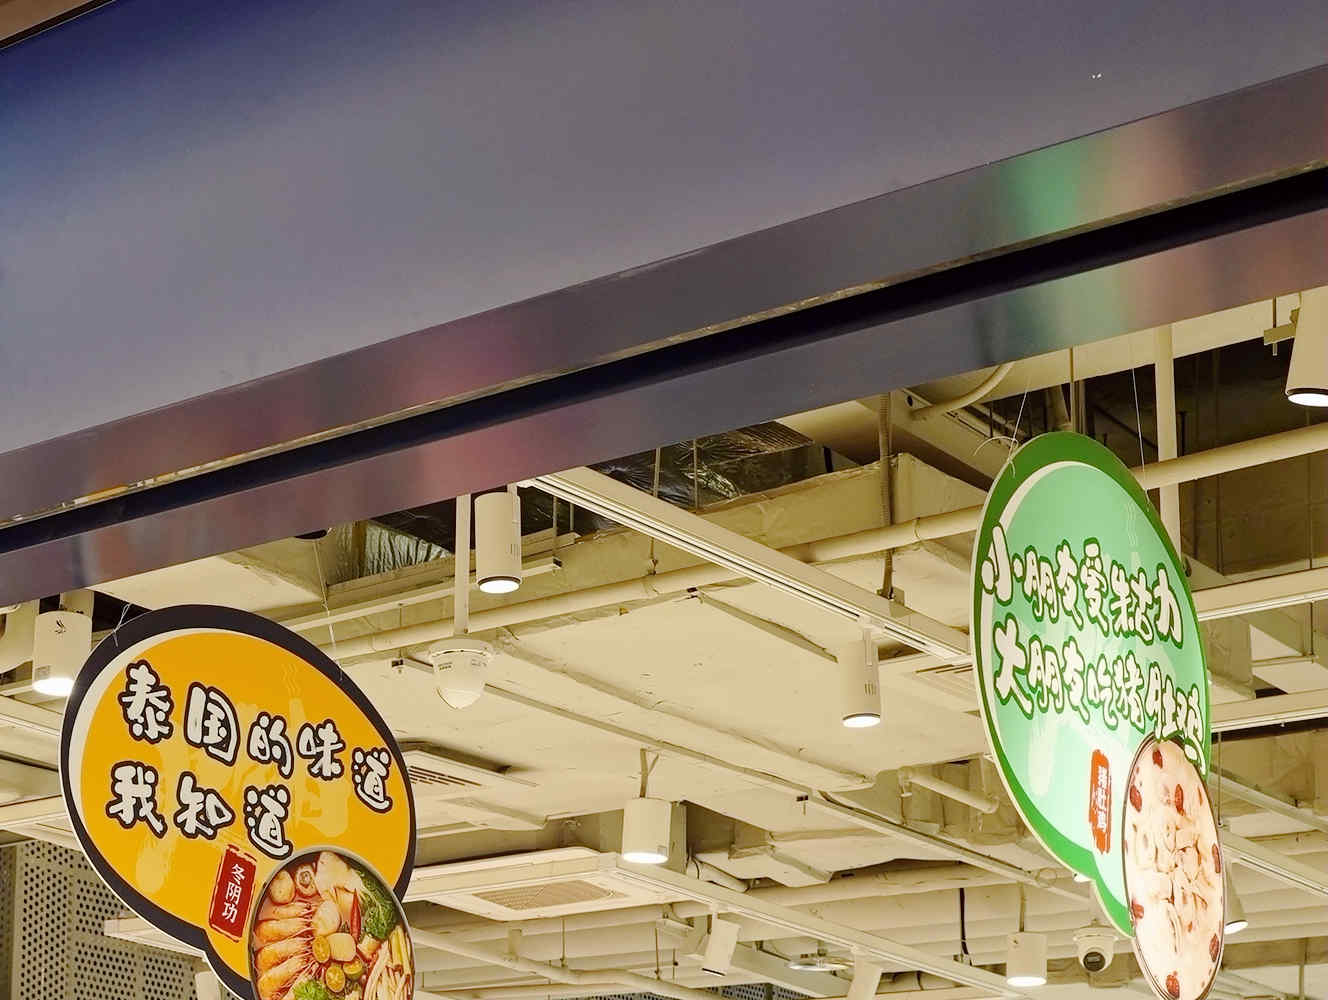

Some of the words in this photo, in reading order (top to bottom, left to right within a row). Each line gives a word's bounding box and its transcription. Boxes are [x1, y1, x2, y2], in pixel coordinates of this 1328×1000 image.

[981, 524, 1183, 649] 小朋友爱朱古力
[118, 660, 392, 813] 泰国的味道
[993, 613, 1207, 776] 大朋友吃猪肚鸡
[106, 761, 293, 859] 我知道
[221, 863, 245, 923] 冬阴功
